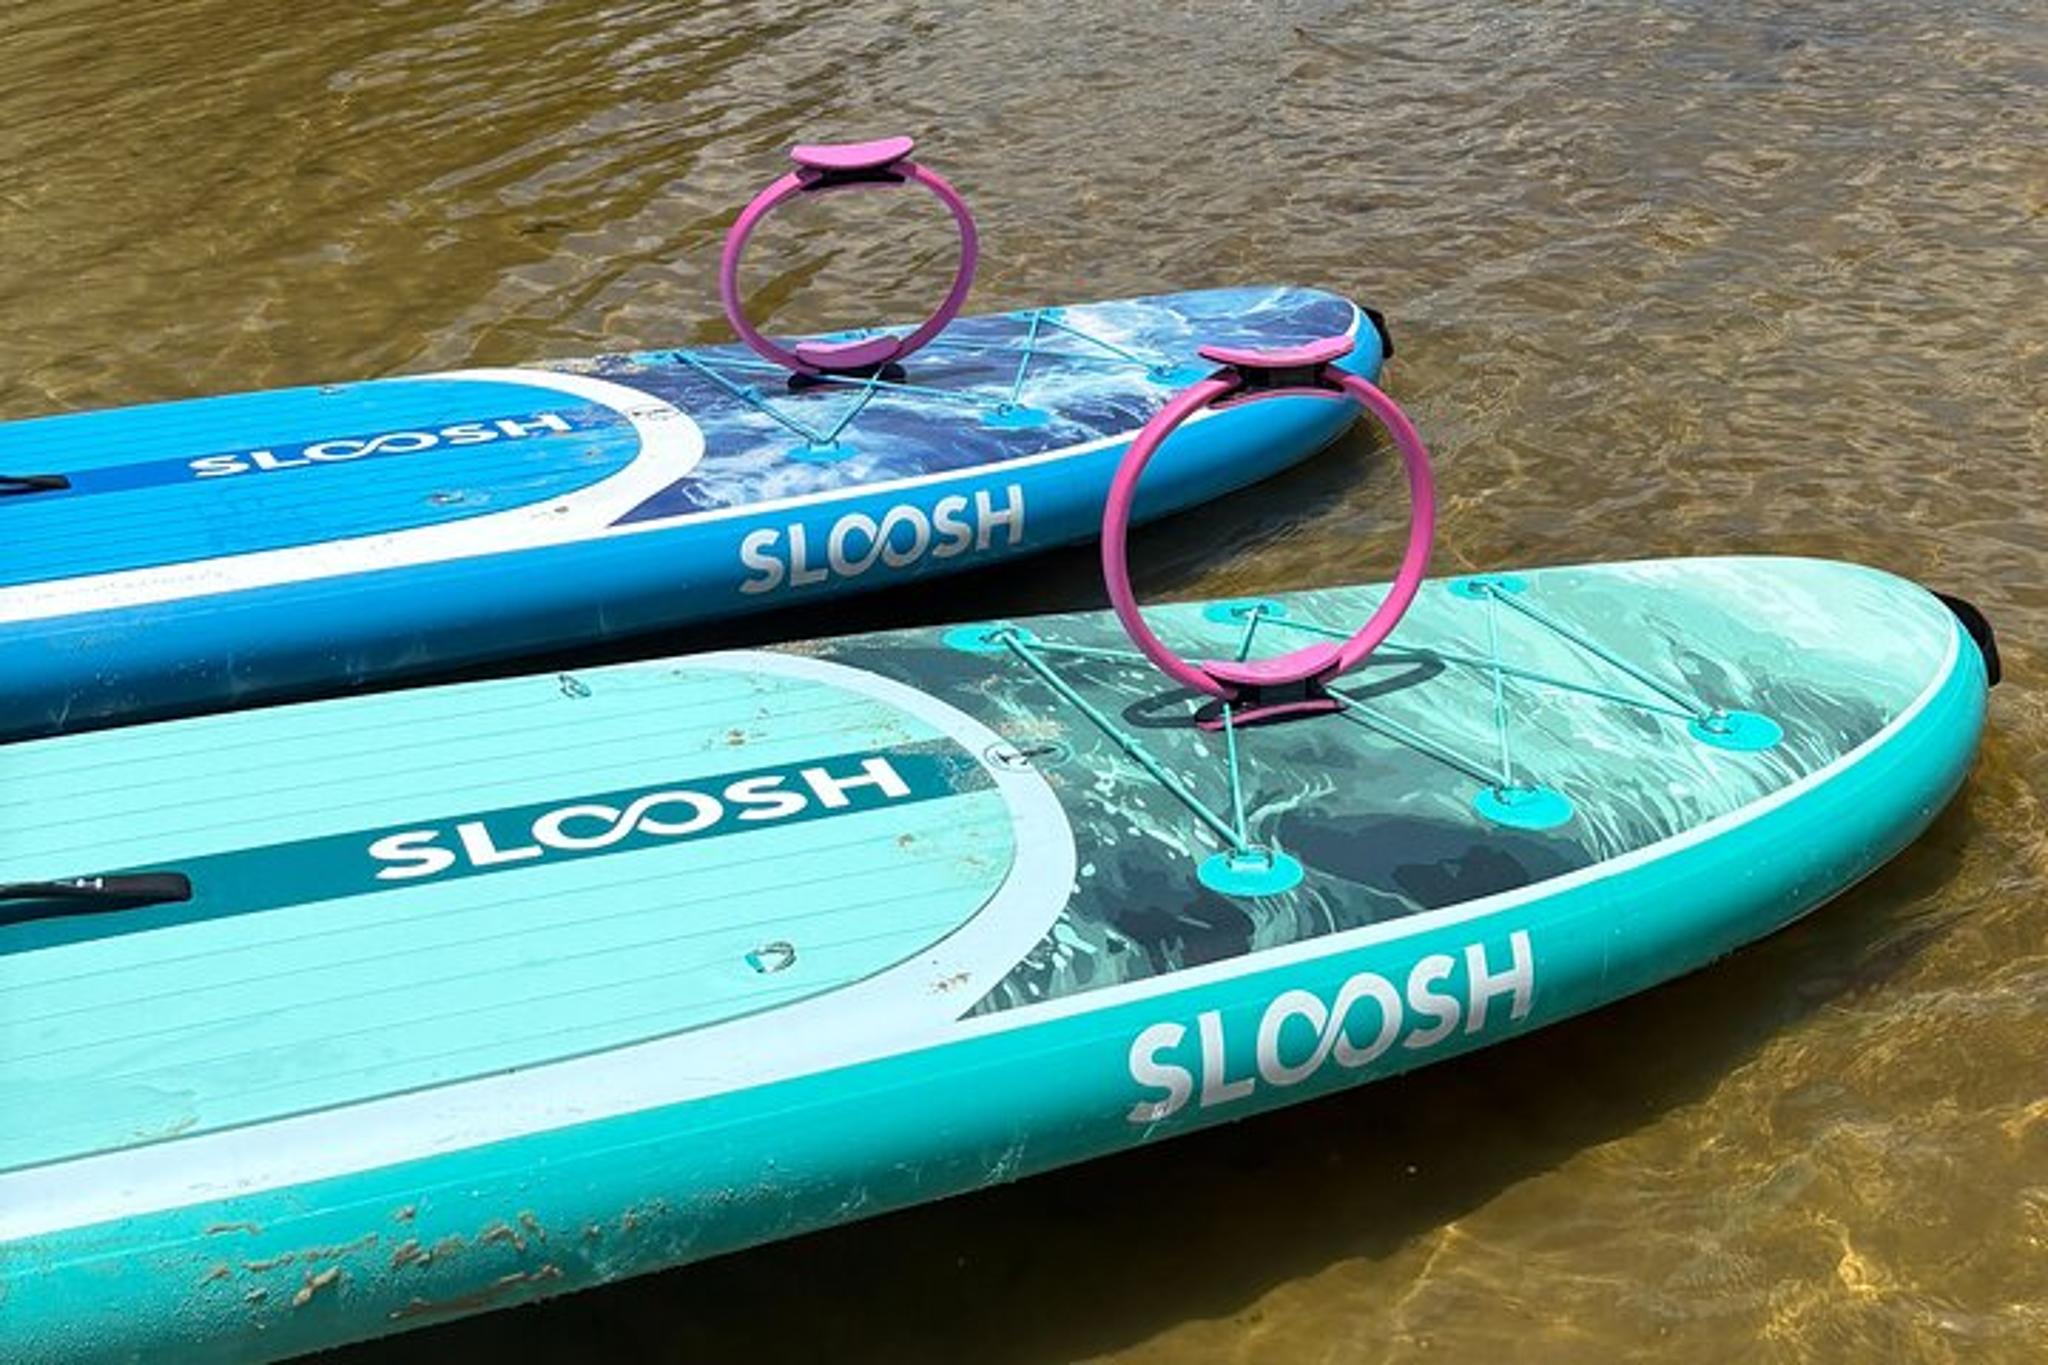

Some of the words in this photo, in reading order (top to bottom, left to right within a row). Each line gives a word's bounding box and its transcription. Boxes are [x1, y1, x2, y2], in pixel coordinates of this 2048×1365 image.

[189, 414, 572, 478] SLOOSH
[738, 483, 1025, 595] SLOOSH
[368, 757, 911, 881] SLOOSH
[1126, 929, 1534, 1124] SLOOSH
